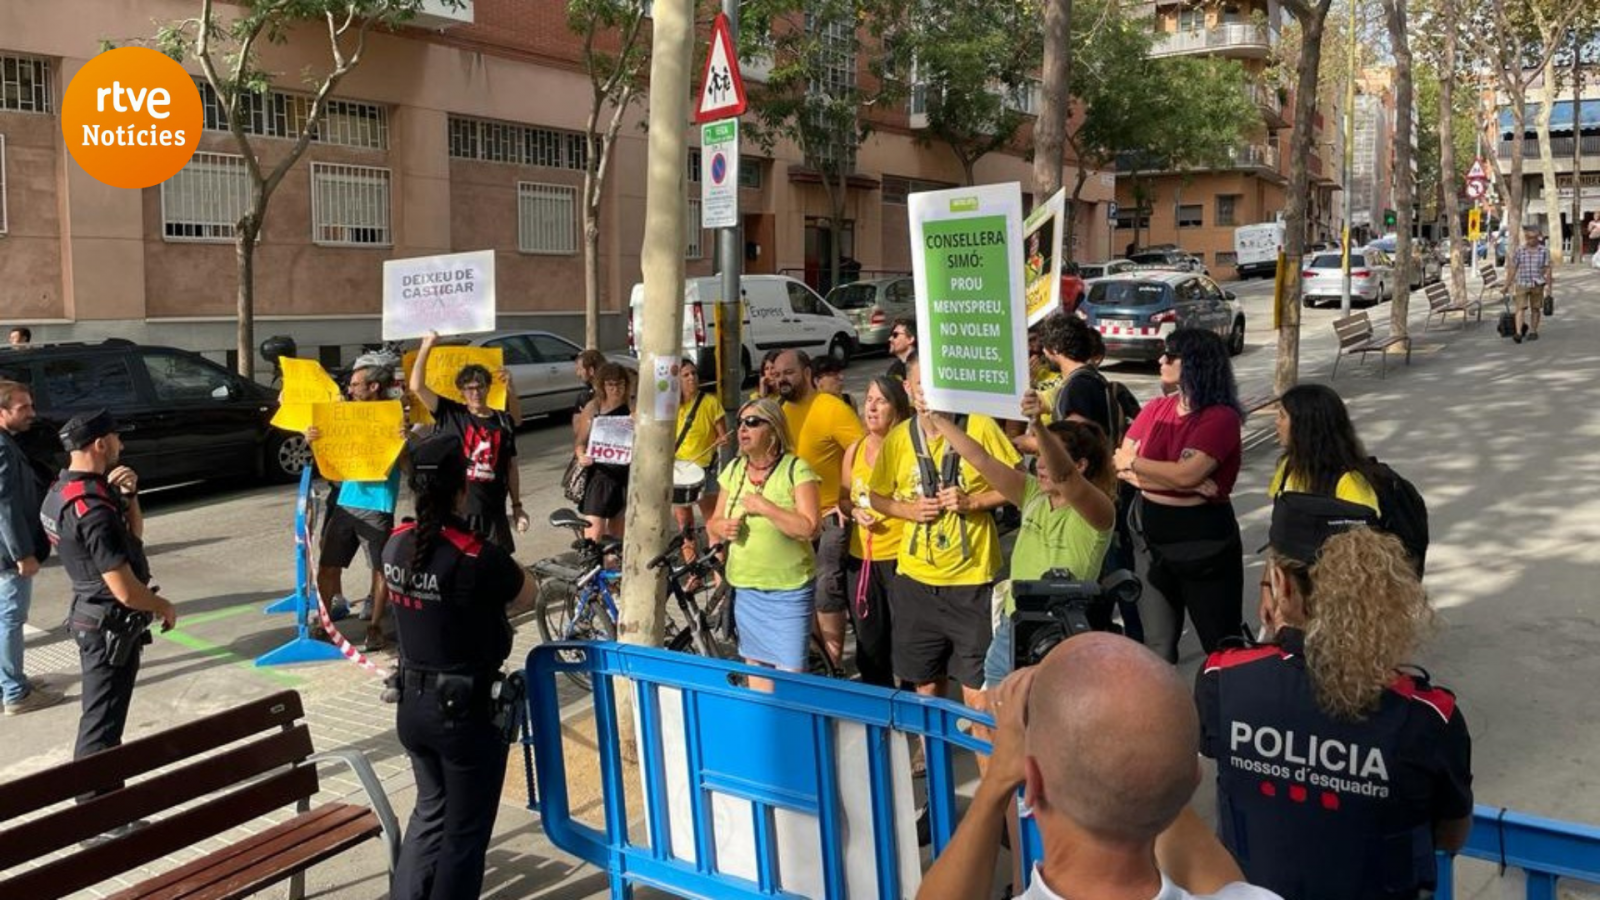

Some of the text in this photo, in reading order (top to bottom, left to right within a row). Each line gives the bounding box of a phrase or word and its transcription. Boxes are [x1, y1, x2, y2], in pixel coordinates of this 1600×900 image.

[926, 231, 1005, 249] CONSELLERA
[947, 249, 984, 268] SIMÓ:
[402, 268, 474, 287] DEIXEU DE
[950, 277, 983, 291] PROU
[402, 281, 474, 299] CASTIGAR
[750, 306, 785, 318] Express
[933, 300, 1006, 315] MENYSPREU,
[940, 323, 1000, 337] NO VOLEM
[941, 345, 1002, 363] PARAULES,
[938, 366, 1009, 384] VOLEM FETS!
[1230, 720, 1389, 780] POLICIA
[1230, 755, 1290, 778] mossos
